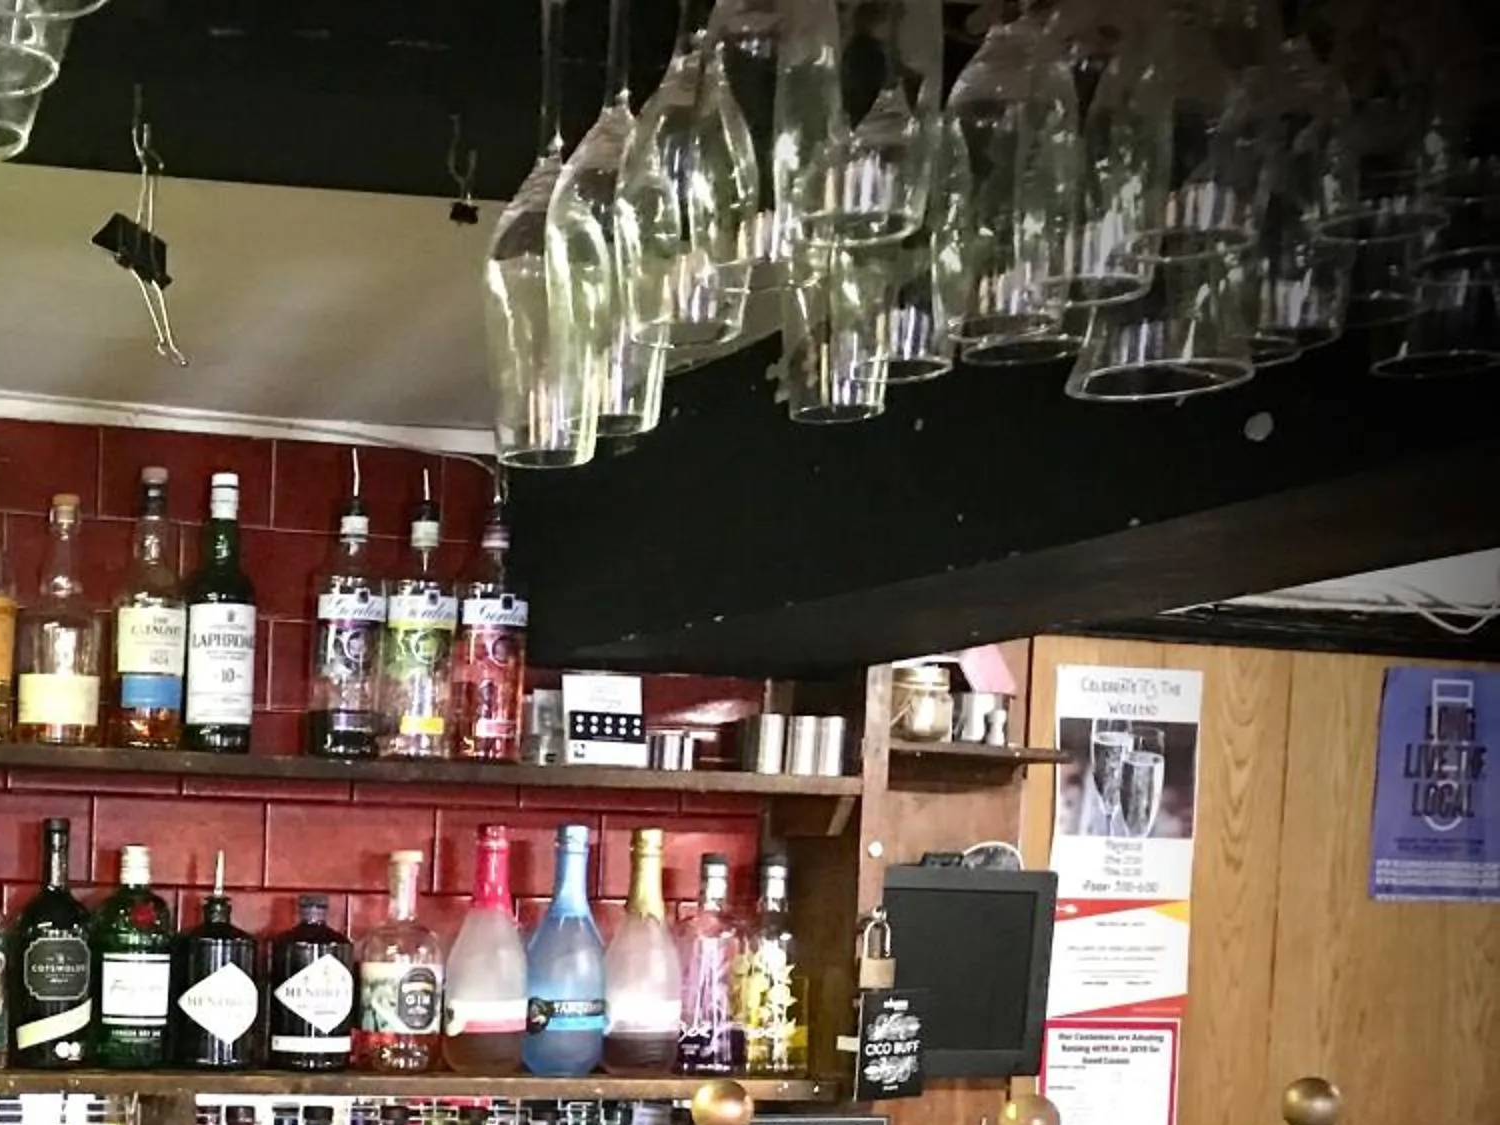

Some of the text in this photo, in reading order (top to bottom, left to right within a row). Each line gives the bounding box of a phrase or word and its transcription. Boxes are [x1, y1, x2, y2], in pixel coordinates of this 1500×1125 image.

[1161, 680, 1182, 697] THE
[1108, 701, 1158, 717] WEEKEND
[405, 994, 431, 1007] GIN
[893, 1039, 921, 1055] BUFF
